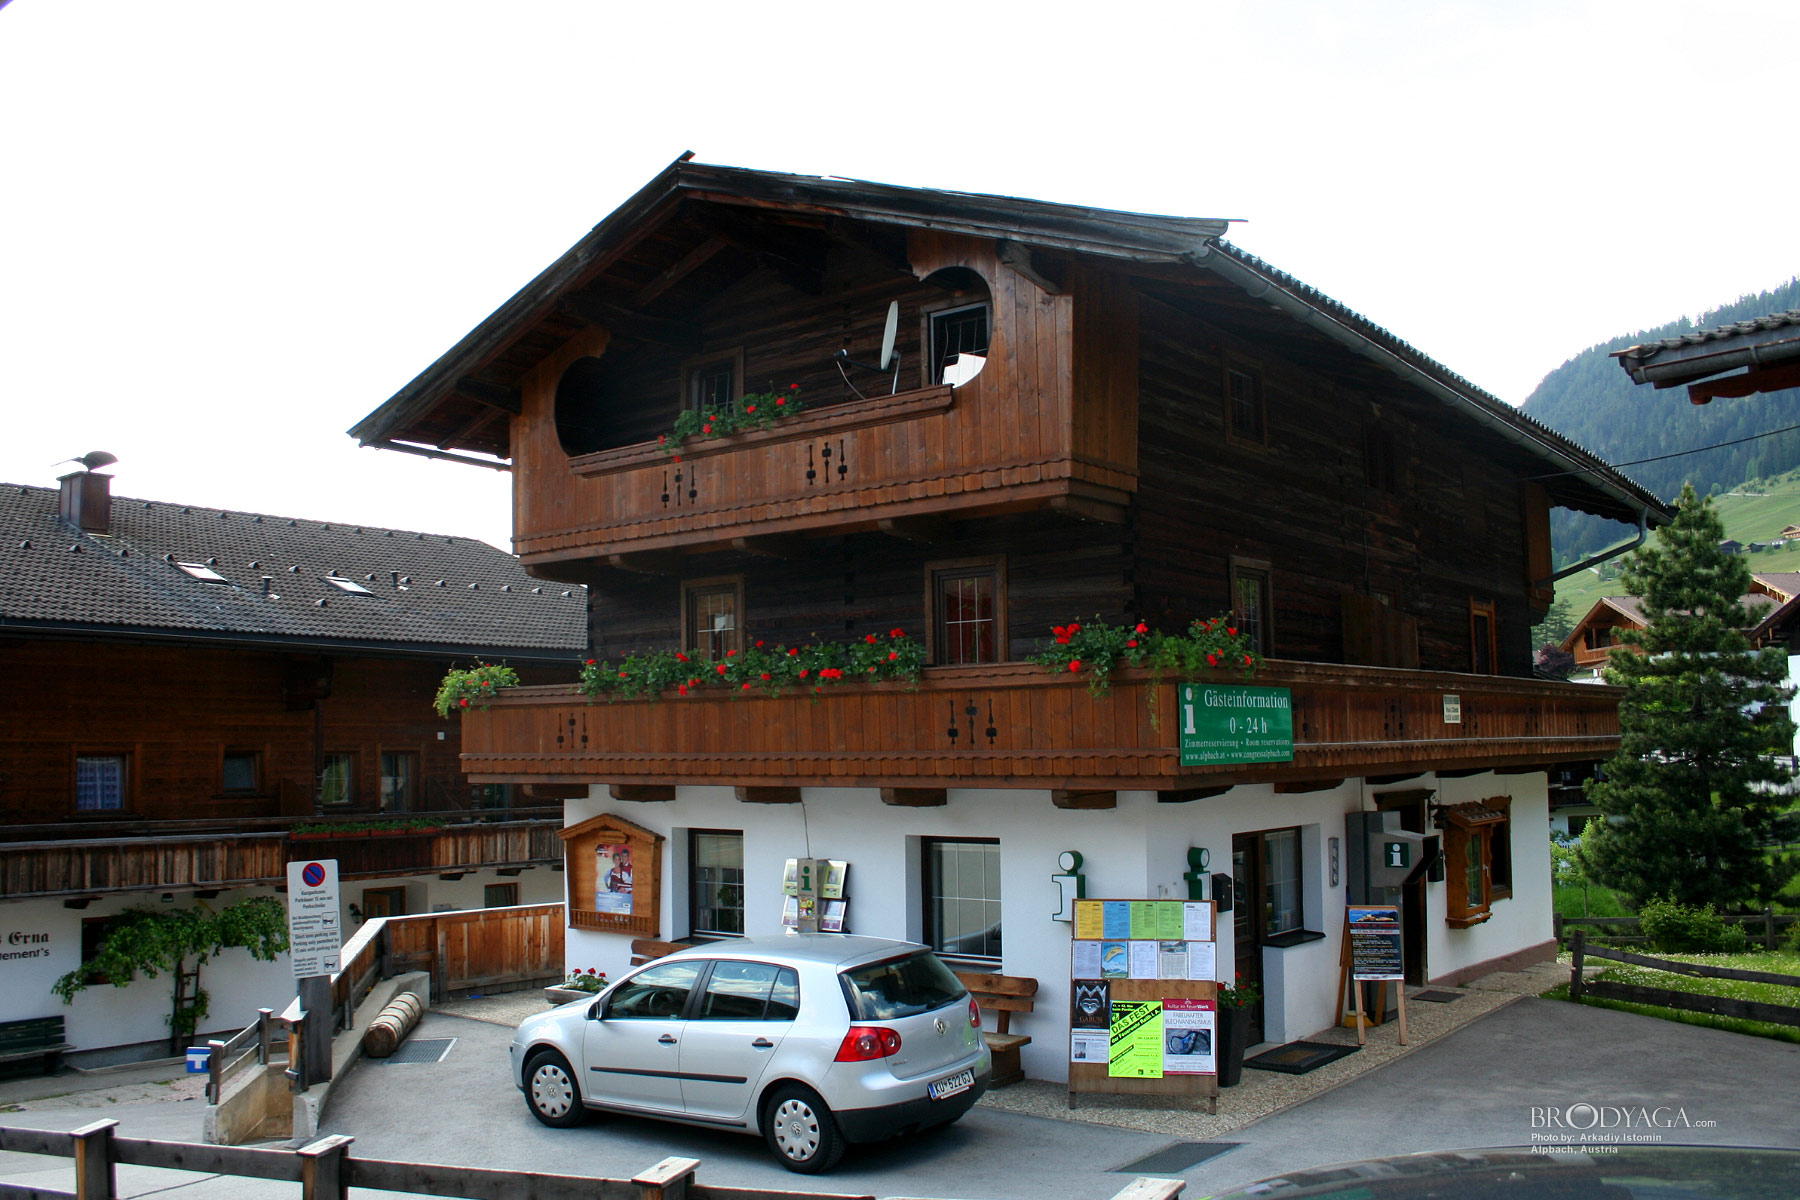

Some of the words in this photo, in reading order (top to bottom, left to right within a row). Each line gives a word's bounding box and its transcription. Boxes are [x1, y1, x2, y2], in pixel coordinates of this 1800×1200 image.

[1204, 689, 1288, 708] Gästeinformation
[1229, 717, 1236, 734] 0
[1246, 717, 1258, 734] 24
[1261, 717, 1268, 734] h
[1185, 738, 1239, 749] Zimmerreservierung
[1245, 738, 1260, 747] Room
[1261, 737, 1290, 747] reservations
[1185, 750, 1226, 762] www.alpbach.at
[9, 931, 49, 946] Erna
[1111, 1018, 1130, 1034] DAS
[1129, 1004, 1150, 1022] FEST
[934, 1081, 945, 1095] KU
